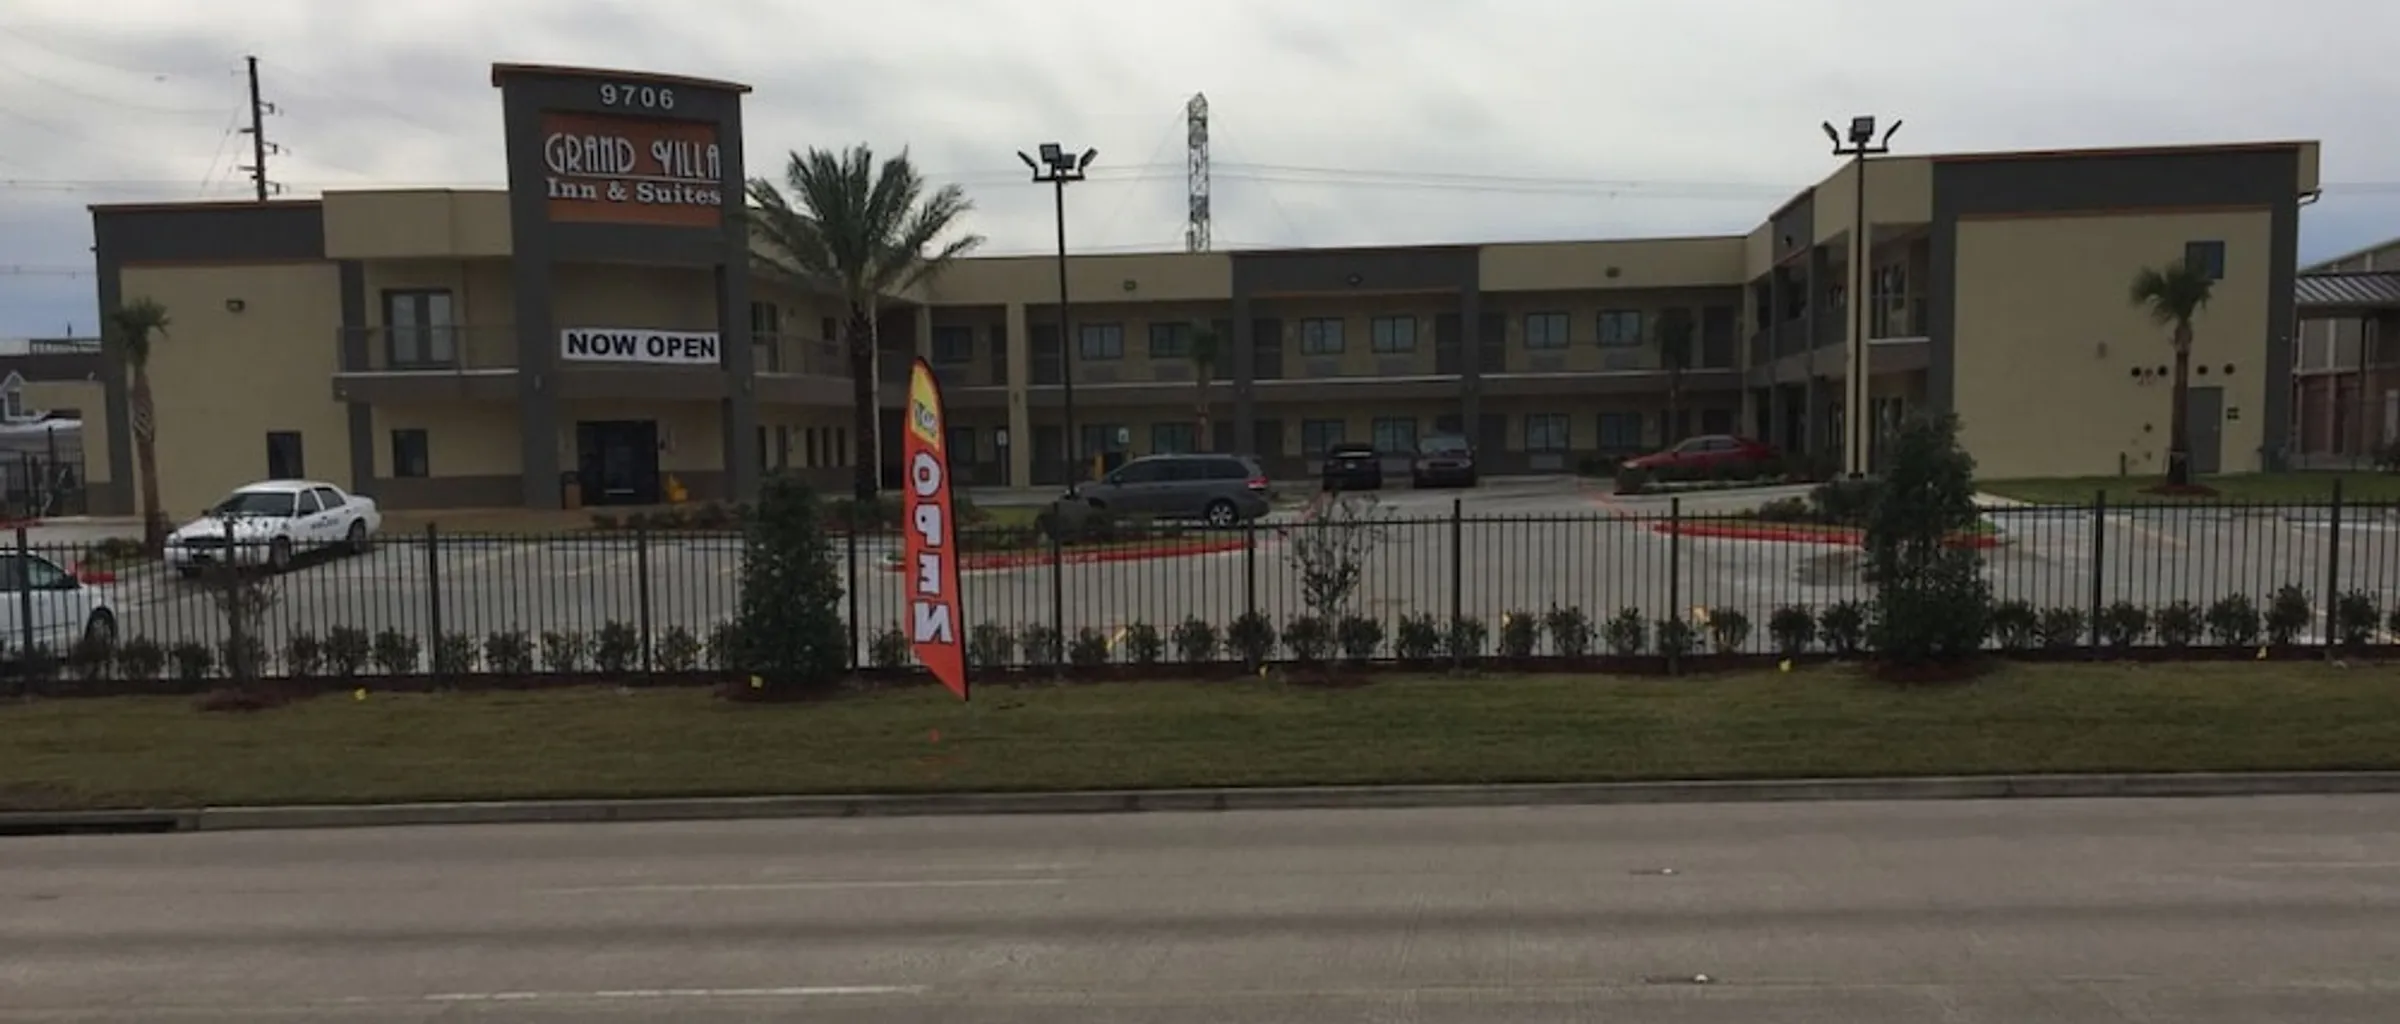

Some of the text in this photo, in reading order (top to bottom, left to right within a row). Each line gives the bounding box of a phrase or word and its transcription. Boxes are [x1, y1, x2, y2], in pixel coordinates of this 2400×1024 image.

[601, 83, 674, 109] 9706
[545, 132, 721, 178] GRAND VILLA
[547, 177, 722, 205] Inn & Suites
[567, 333, 715, 357] NOW OPEN
